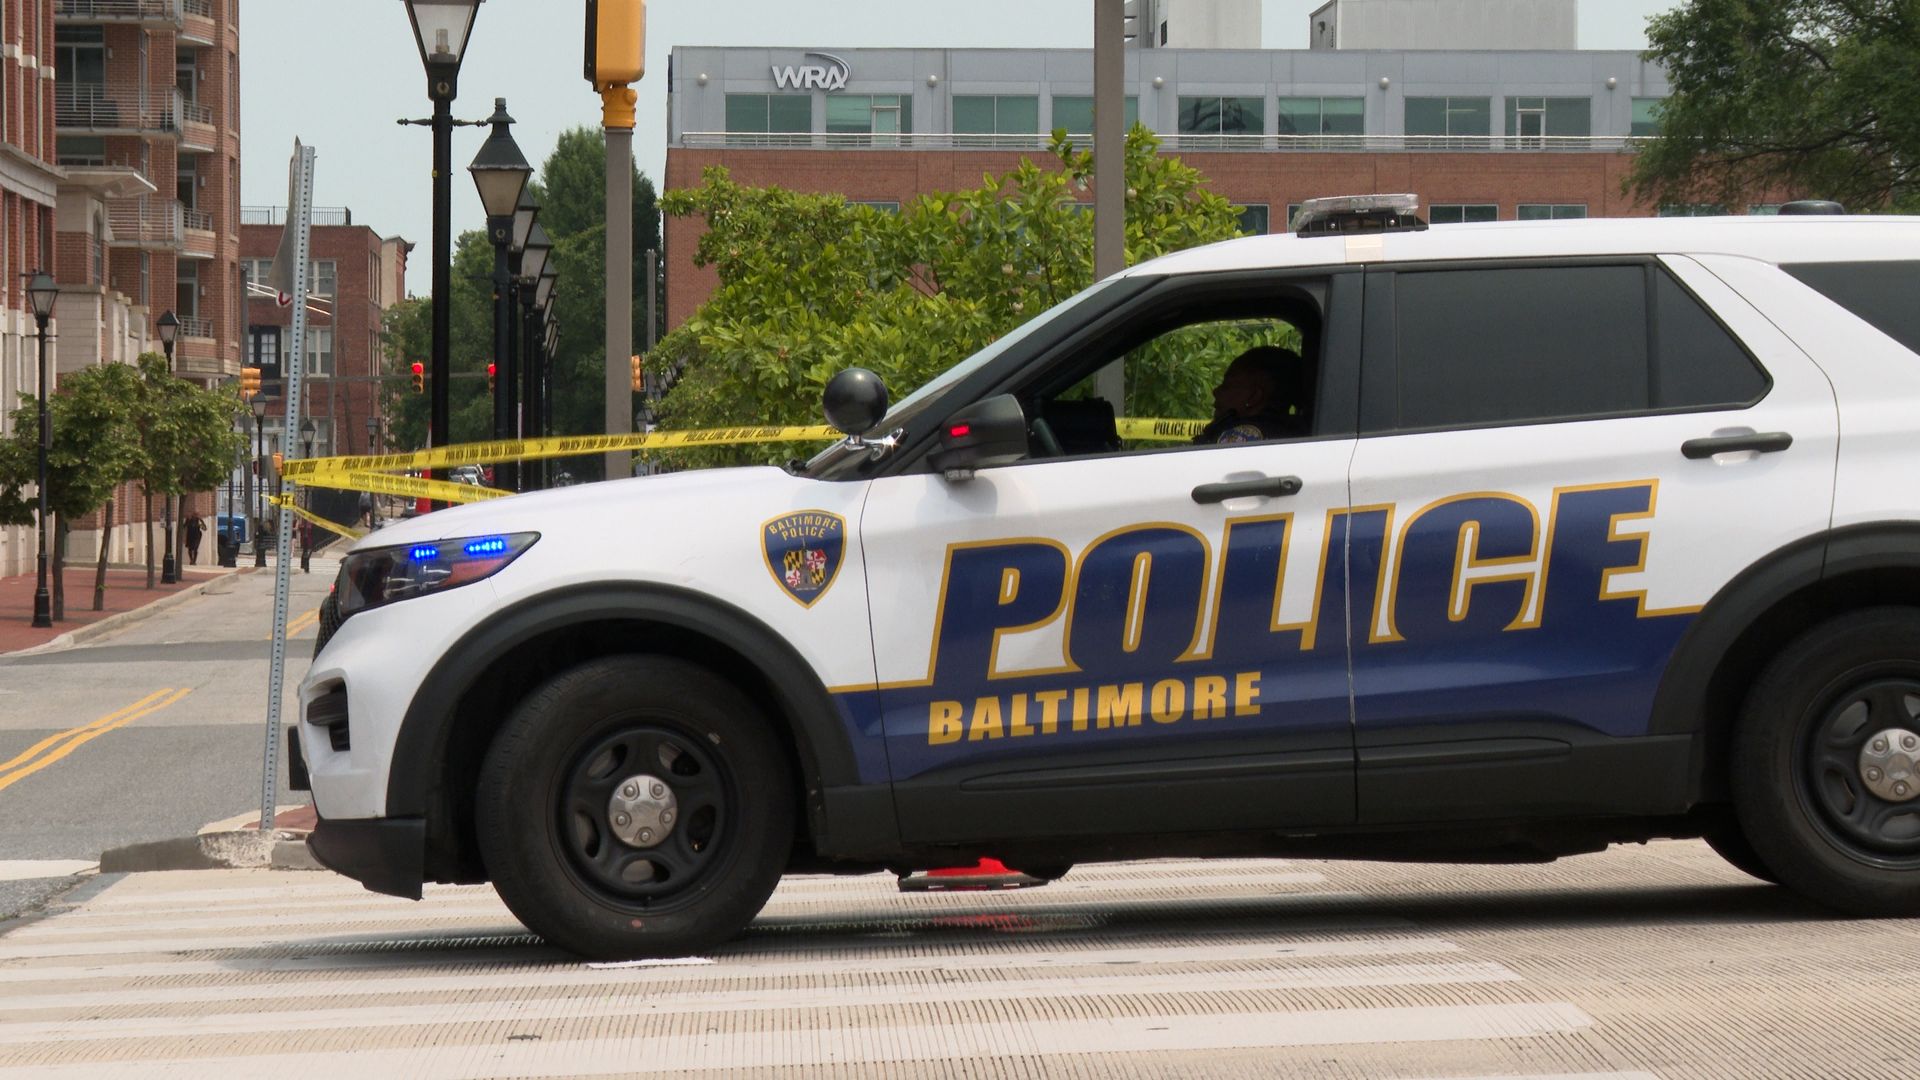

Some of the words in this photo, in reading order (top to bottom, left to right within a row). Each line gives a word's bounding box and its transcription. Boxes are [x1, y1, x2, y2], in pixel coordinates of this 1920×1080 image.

[771, 62, 848, 91] WRA
[683, 431, 709, 441] POLICE
[707, 429, 728, 440] LINE
[725, 430, 740, 440] DO
[739, 428, 757, 439] NOT
[755, 427, 782, 438] CROSS
[1153, 421, 1186, 436] POLICE
[768, 515, 839, 535] BALTIMORE
[781, 526, 826, 541] POLICE
[931, 478, 1695, 687] POLICE
[927, 671, 1262, 746] BALTIMORE
